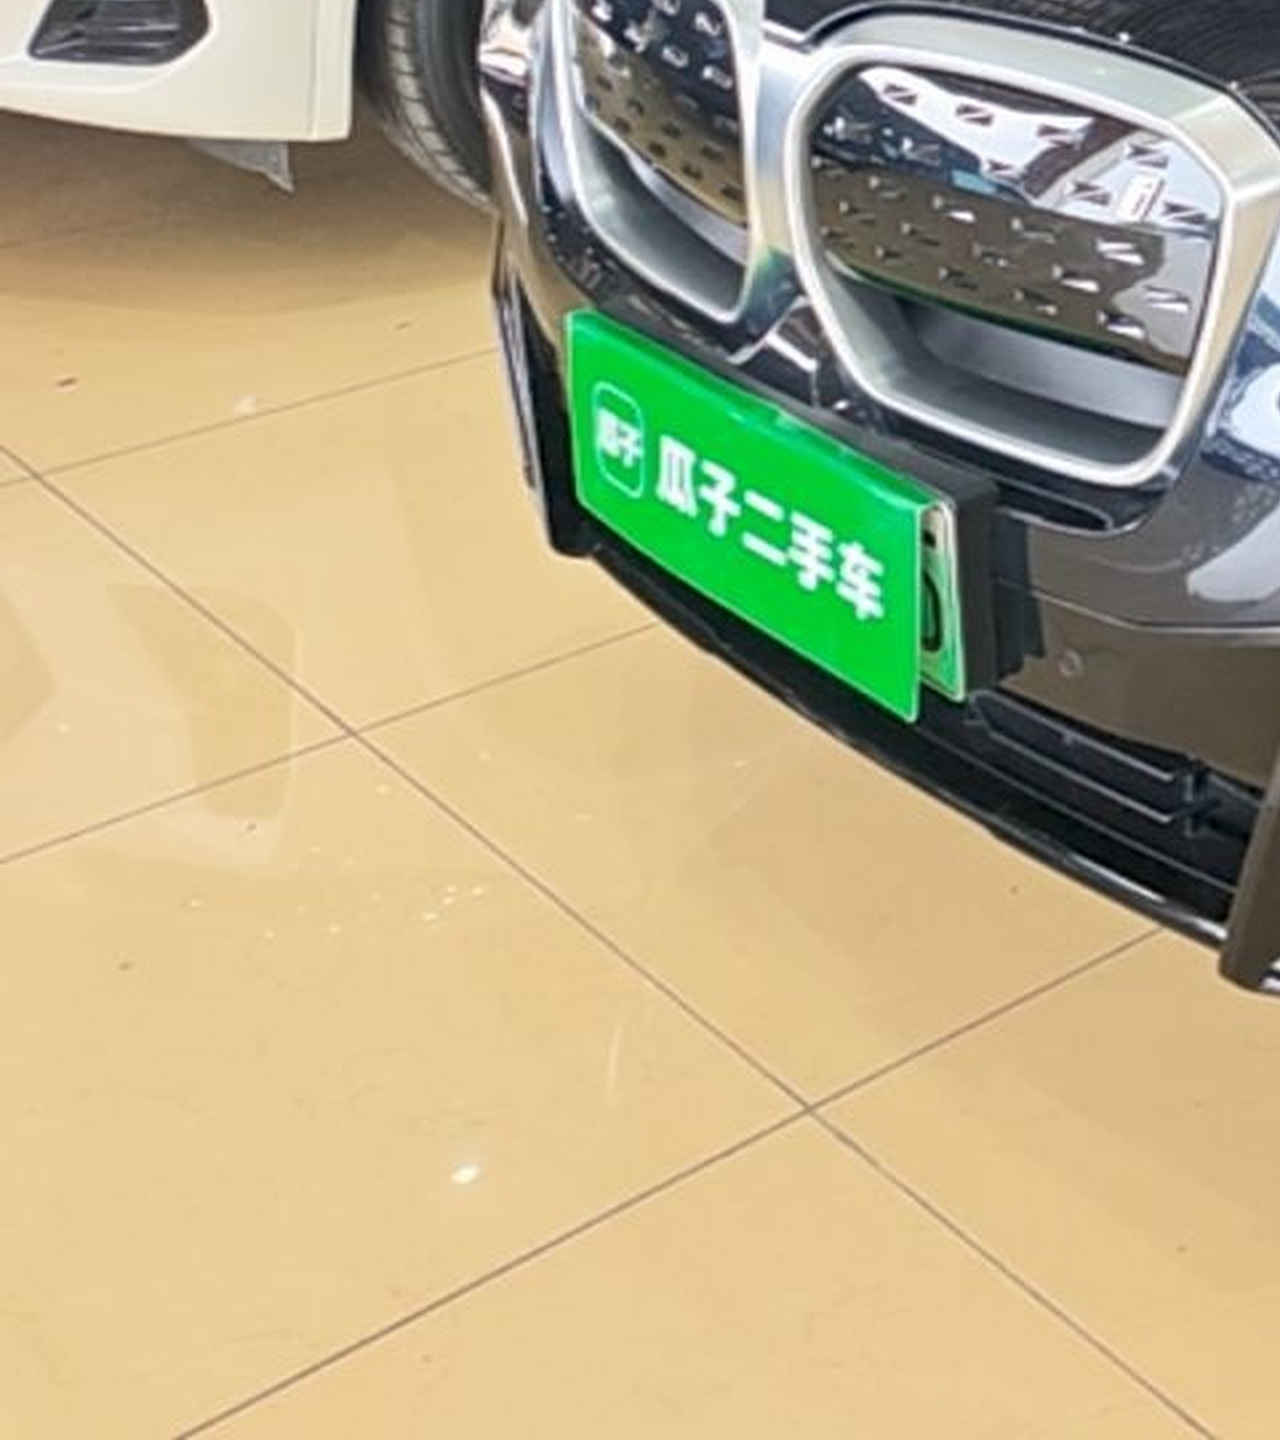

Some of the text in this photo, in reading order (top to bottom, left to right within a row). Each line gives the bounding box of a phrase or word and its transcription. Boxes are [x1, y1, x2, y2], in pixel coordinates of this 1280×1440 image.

[655, 434, 885, 621] 瓜子二手车
